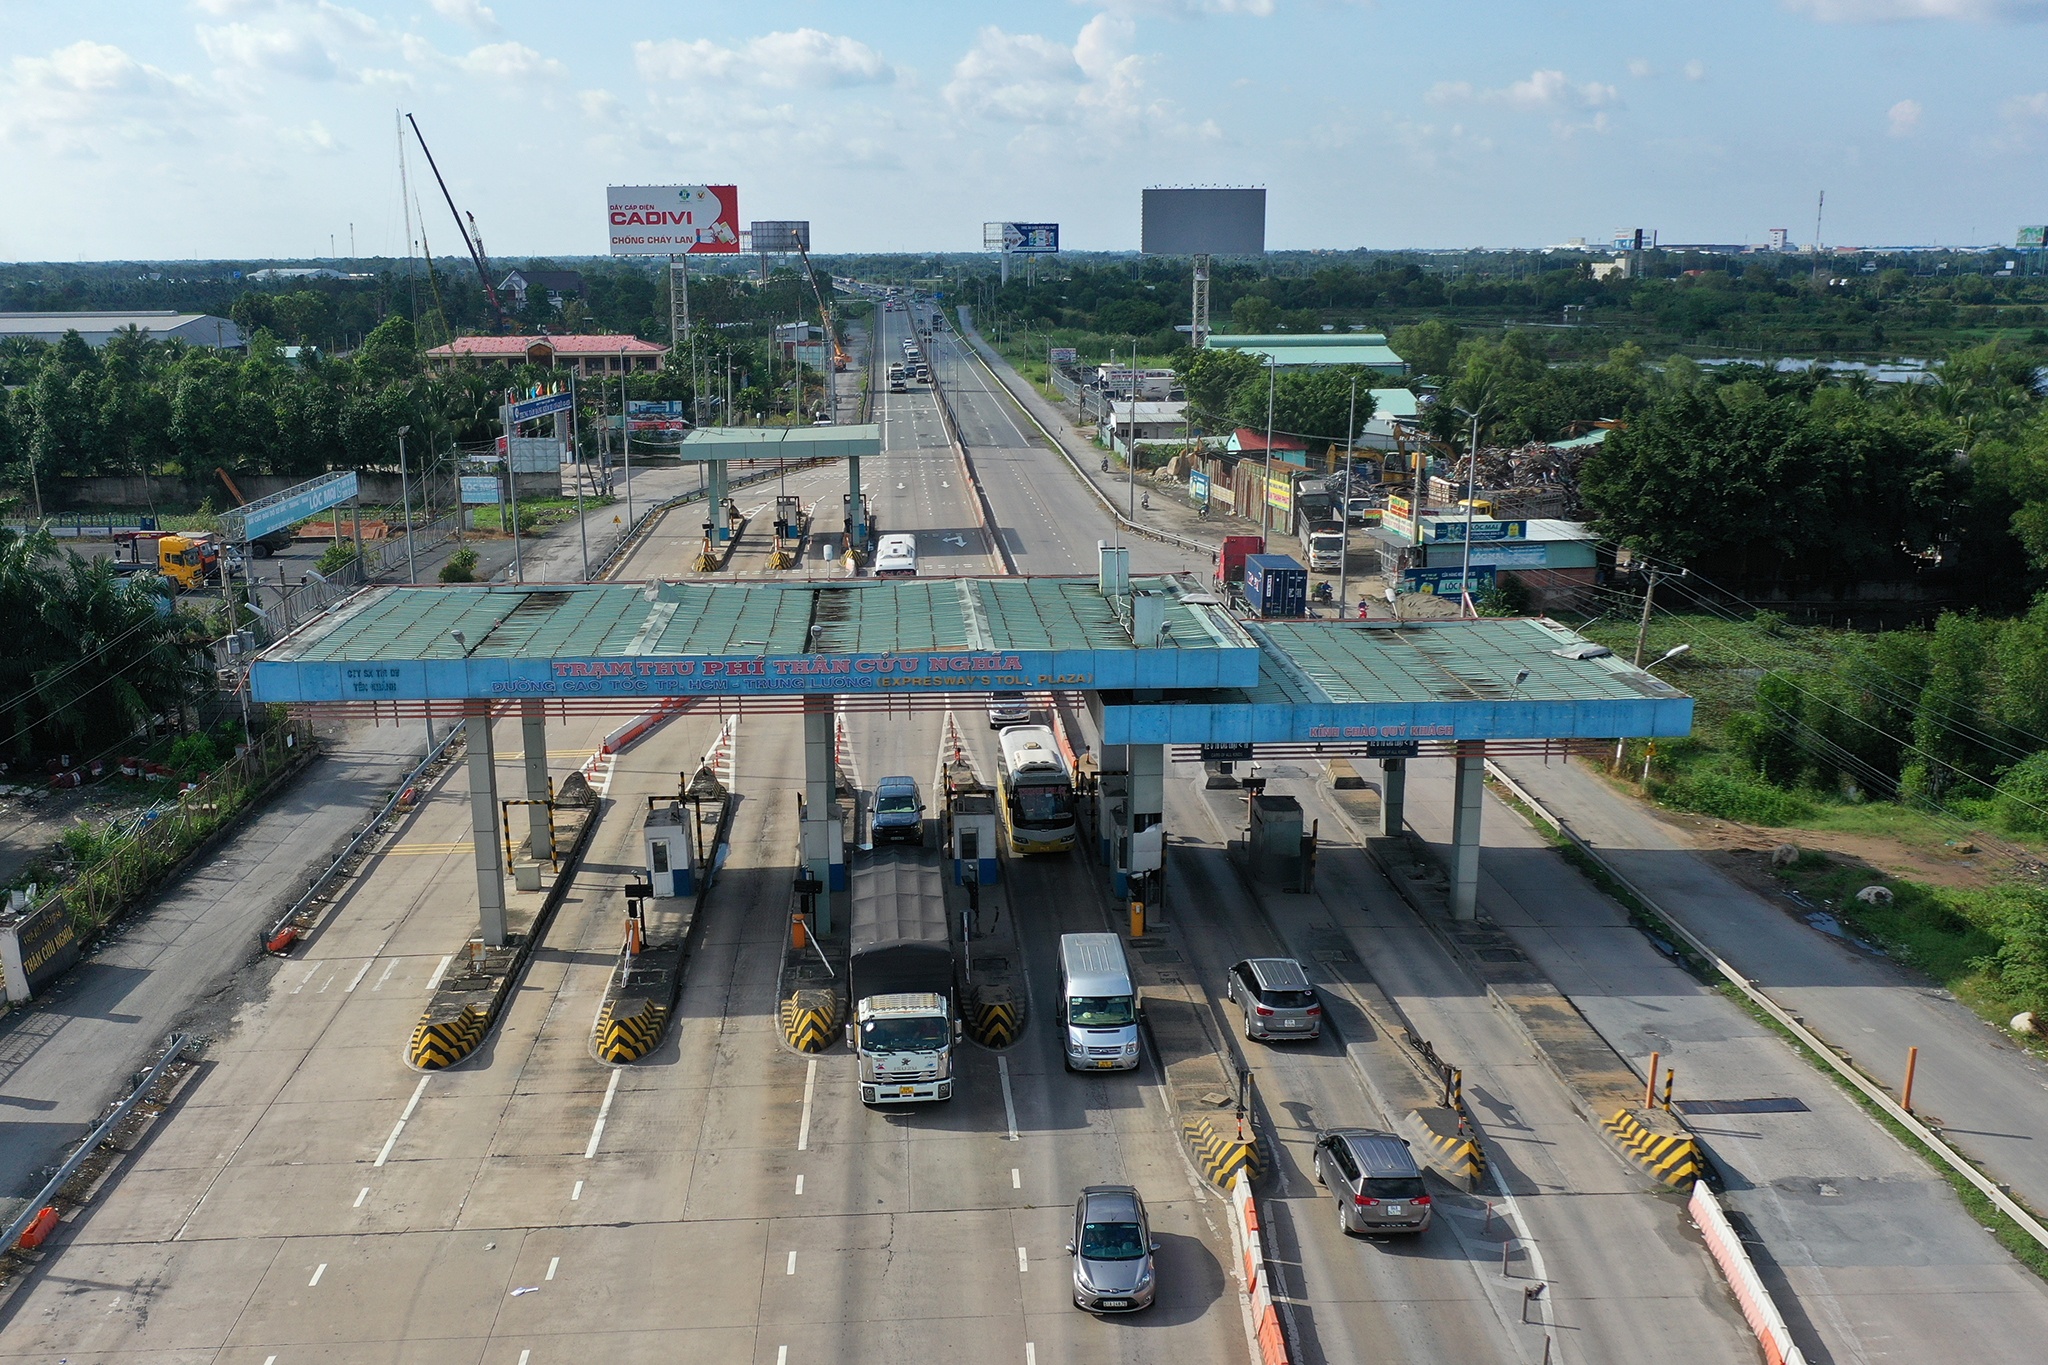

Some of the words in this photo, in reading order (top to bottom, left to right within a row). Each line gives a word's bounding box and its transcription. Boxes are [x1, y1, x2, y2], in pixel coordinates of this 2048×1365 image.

[610, 211, 692, 225] CADIVI
[611, 234, 645, 244] CHỐNG
[647, 234, 672, 243] CHÁY
[309, 491, 323, 510] LỘC
[1445, 582, 1458, 591] LỘC
[553, 661, 633, 679] TRẠM
[637, 661, 696, 676] THU
[702, 655, 765, 676] PHÍ
[773, 655, 851, 675] THÂN
[855, 651, 919, 673] CỬU
[929, 651, 1022, 672] NGHĨA
[491, 676, 557, 692] ĐƯỜNG
[562, 679, 602, 691] CAO
[609, 675, 648, 691] TỐC
[656, 679, 684, 690] TP.
[689, 678, 729, 690] HCM
[743, 677, 804, 689] TRUNG
[810, 676, 872, 689] LƯƠNG
[1038, 672, 1094, 684] PLAZA)
[1309, 723, 1340, 738] KÍNH
[1343, 723, 1378, 737] CHÀO
[1381, 722, 1407, 738] QUÝ
[1410, 722, 1454, 737] KHÁCH
[23, 951, 43, 975] THÂN
[54, 923, 75, 950] NGHĨA
